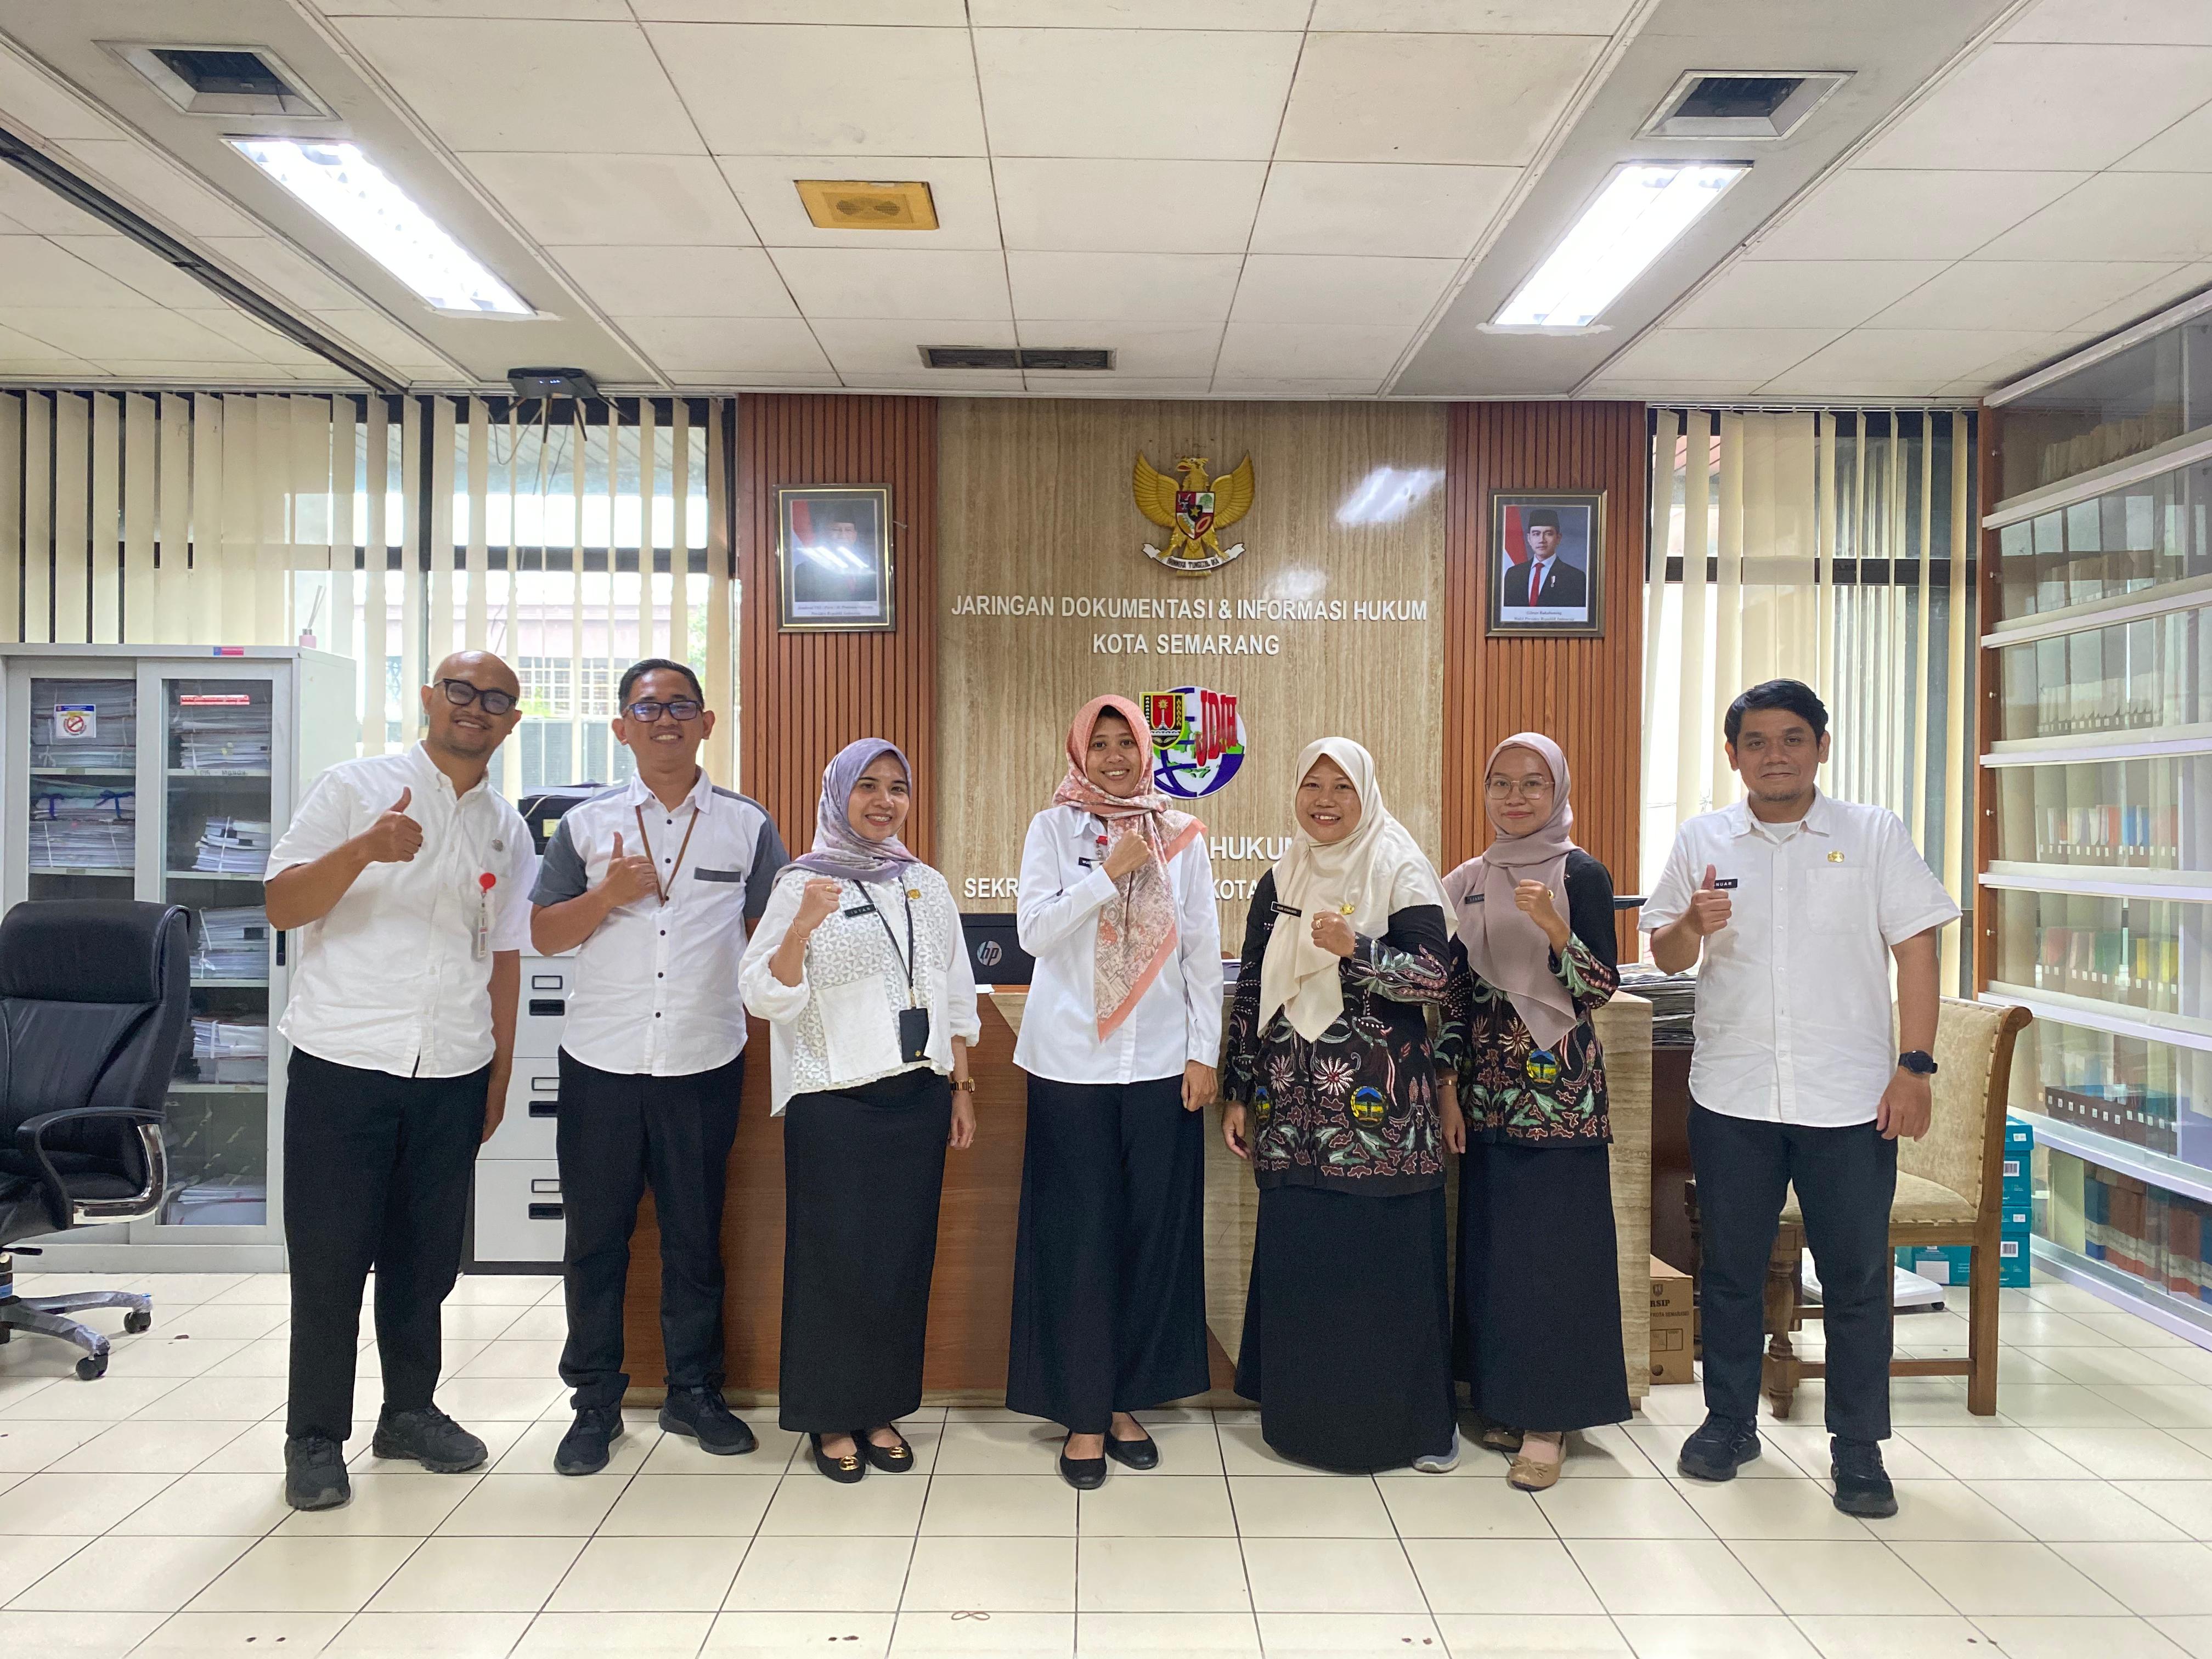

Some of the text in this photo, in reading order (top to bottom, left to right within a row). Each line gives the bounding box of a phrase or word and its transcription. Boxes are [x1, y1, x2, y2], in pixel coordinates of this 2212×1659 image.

[951, 595, 1427, 621] JARINGAN DOKUMENTASI & INFORMASI HUKUM
[1093, 634, 1279, 655] KOTA SEMARANG
[1195, 690, 1238, 767] JDIH
[964, 878, 1019, 898] SEKR
[978, 940, 1001, 966] hp
[1650, 1299, 1670, 1307] RSIP
